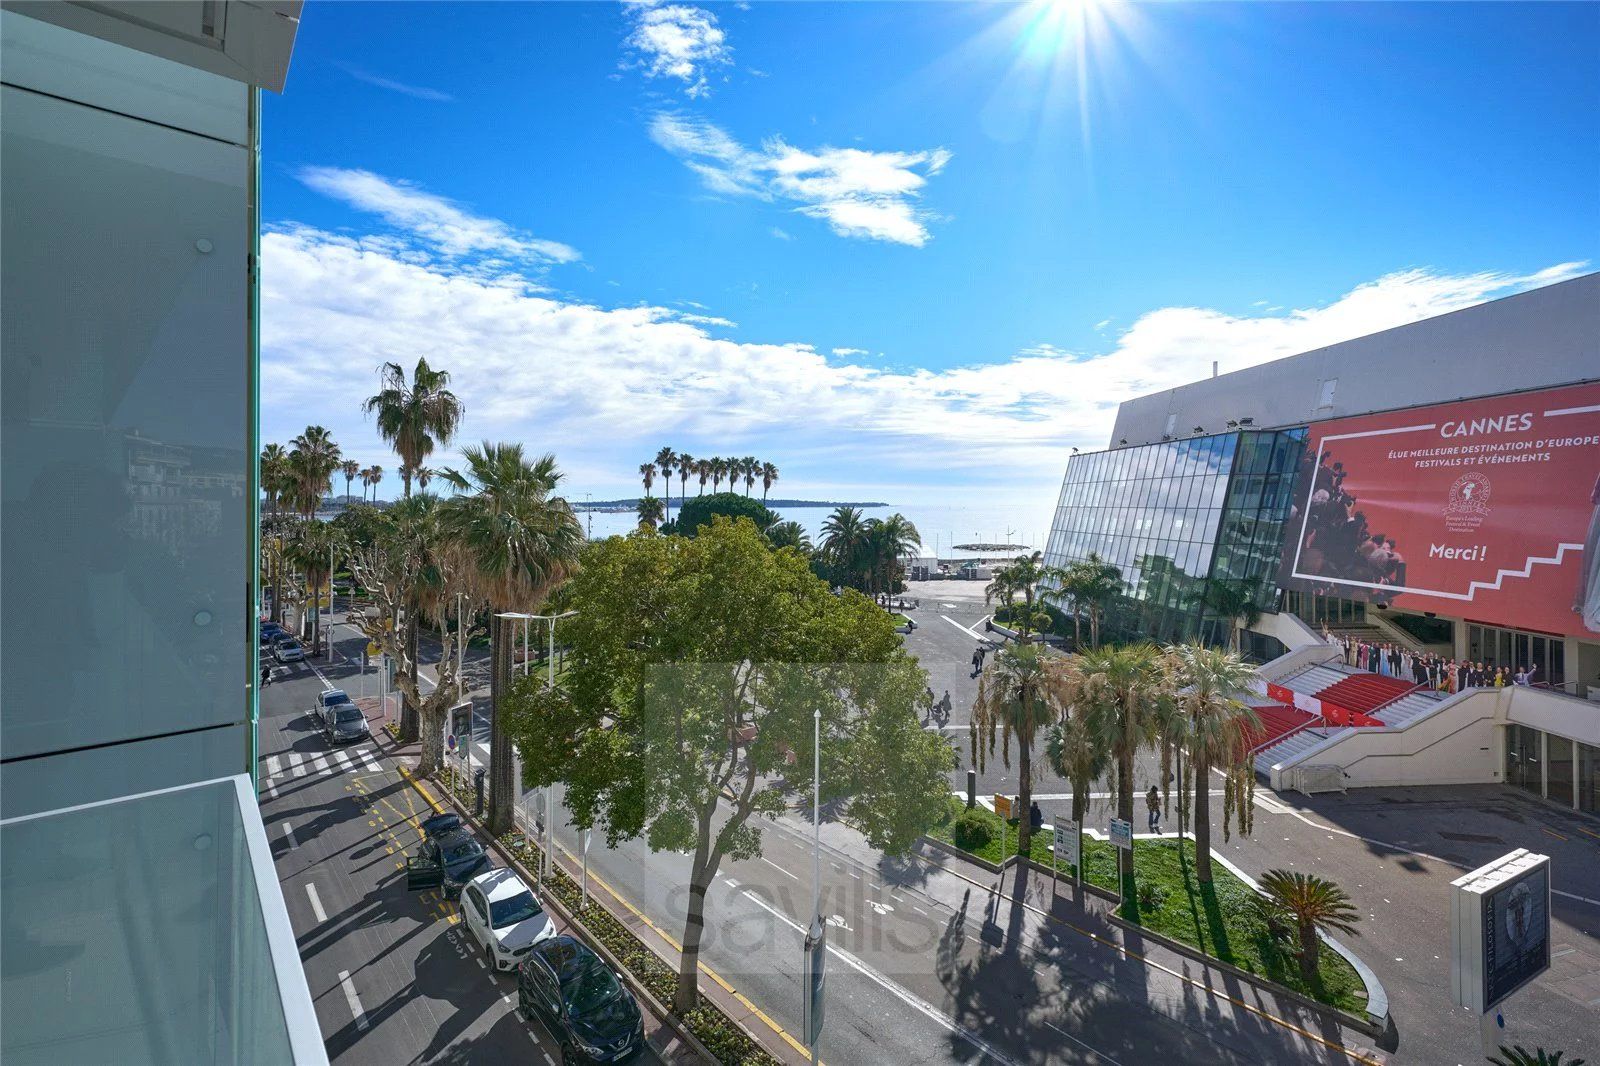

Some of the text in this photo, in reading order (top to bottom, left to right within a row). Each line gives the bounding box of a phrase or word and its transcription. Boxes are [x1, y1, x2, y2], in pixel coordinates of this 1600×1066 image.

[1440, 412, 1533, 438] CANNES
[1388, 448, 1408, 459] ÉLUE
[1410, 446, 1459, 458] MEILLEURE
[1461, 441, 1533, 454] DESTINATION
[1415, 459, 1461, 468] FESTIVALS
[1464, 457, 1476, 465] ET
